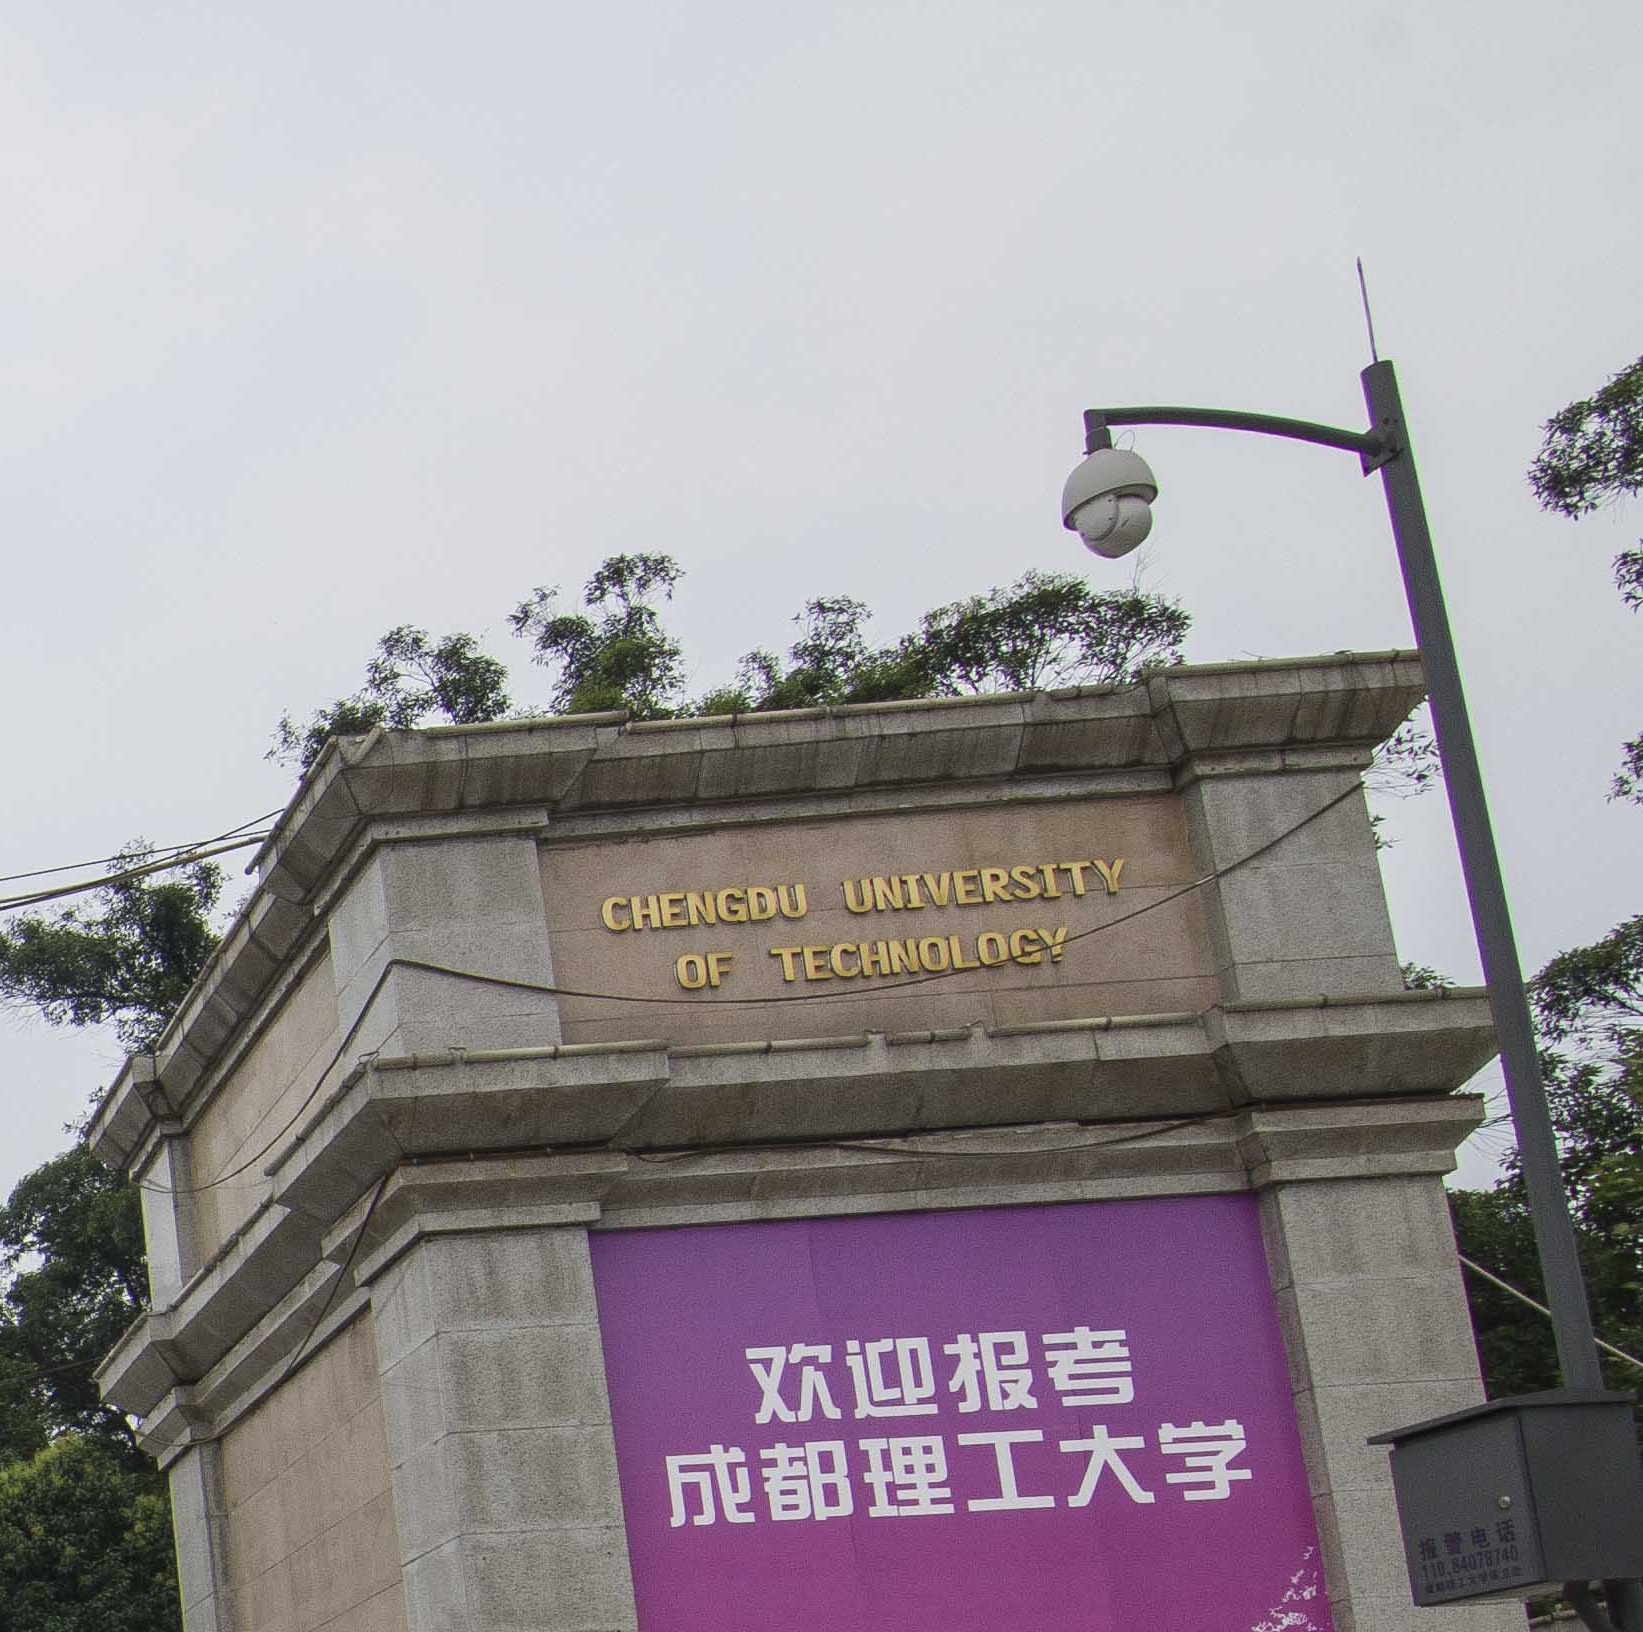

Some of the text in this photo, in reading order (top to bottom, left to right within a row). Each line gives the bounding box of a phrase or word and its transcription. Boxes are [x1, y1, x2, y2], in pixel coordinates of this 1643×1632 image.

[601, 858, 1125, 932] CHENGDU UNIVERSITY
[676, 927, 1070, 990] OF TECHNOLOGY
[745, 1326, 1135, 1425] 欢迎报考
[666, 1419, 1253, 1528] 成都理工大学
